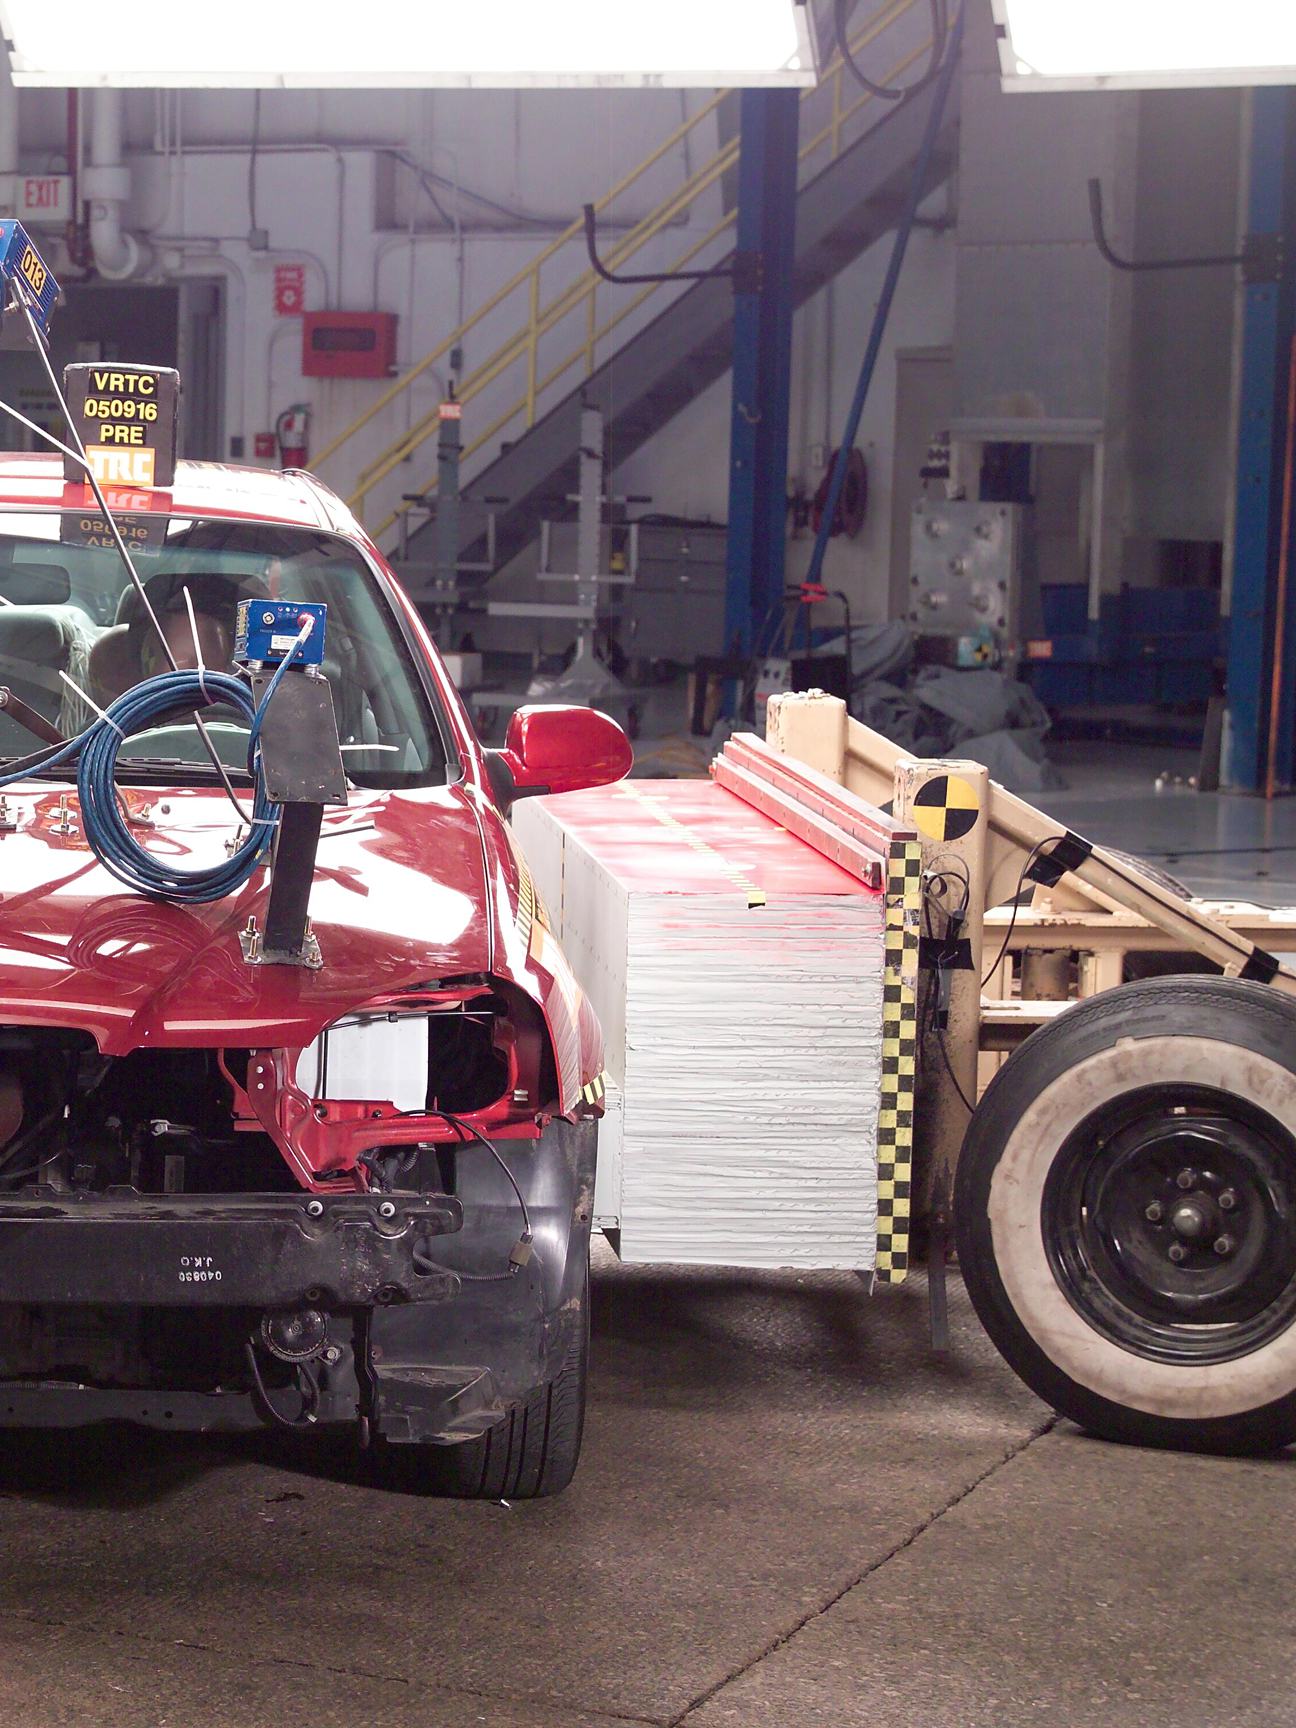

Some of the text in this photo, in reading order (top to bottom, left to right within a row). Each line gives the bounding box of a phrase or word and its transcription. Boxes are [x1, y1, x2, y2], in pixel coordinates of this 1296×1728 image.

[24, 178, 61, 209] EXIT
[22, 250, 45, 292] 013
[93, 372, 155, 394] VRTC
[84, 398, 158, 421] 050916
[99, 423, 145, 445] PRE
[88, 450, 152, 482] TRC
